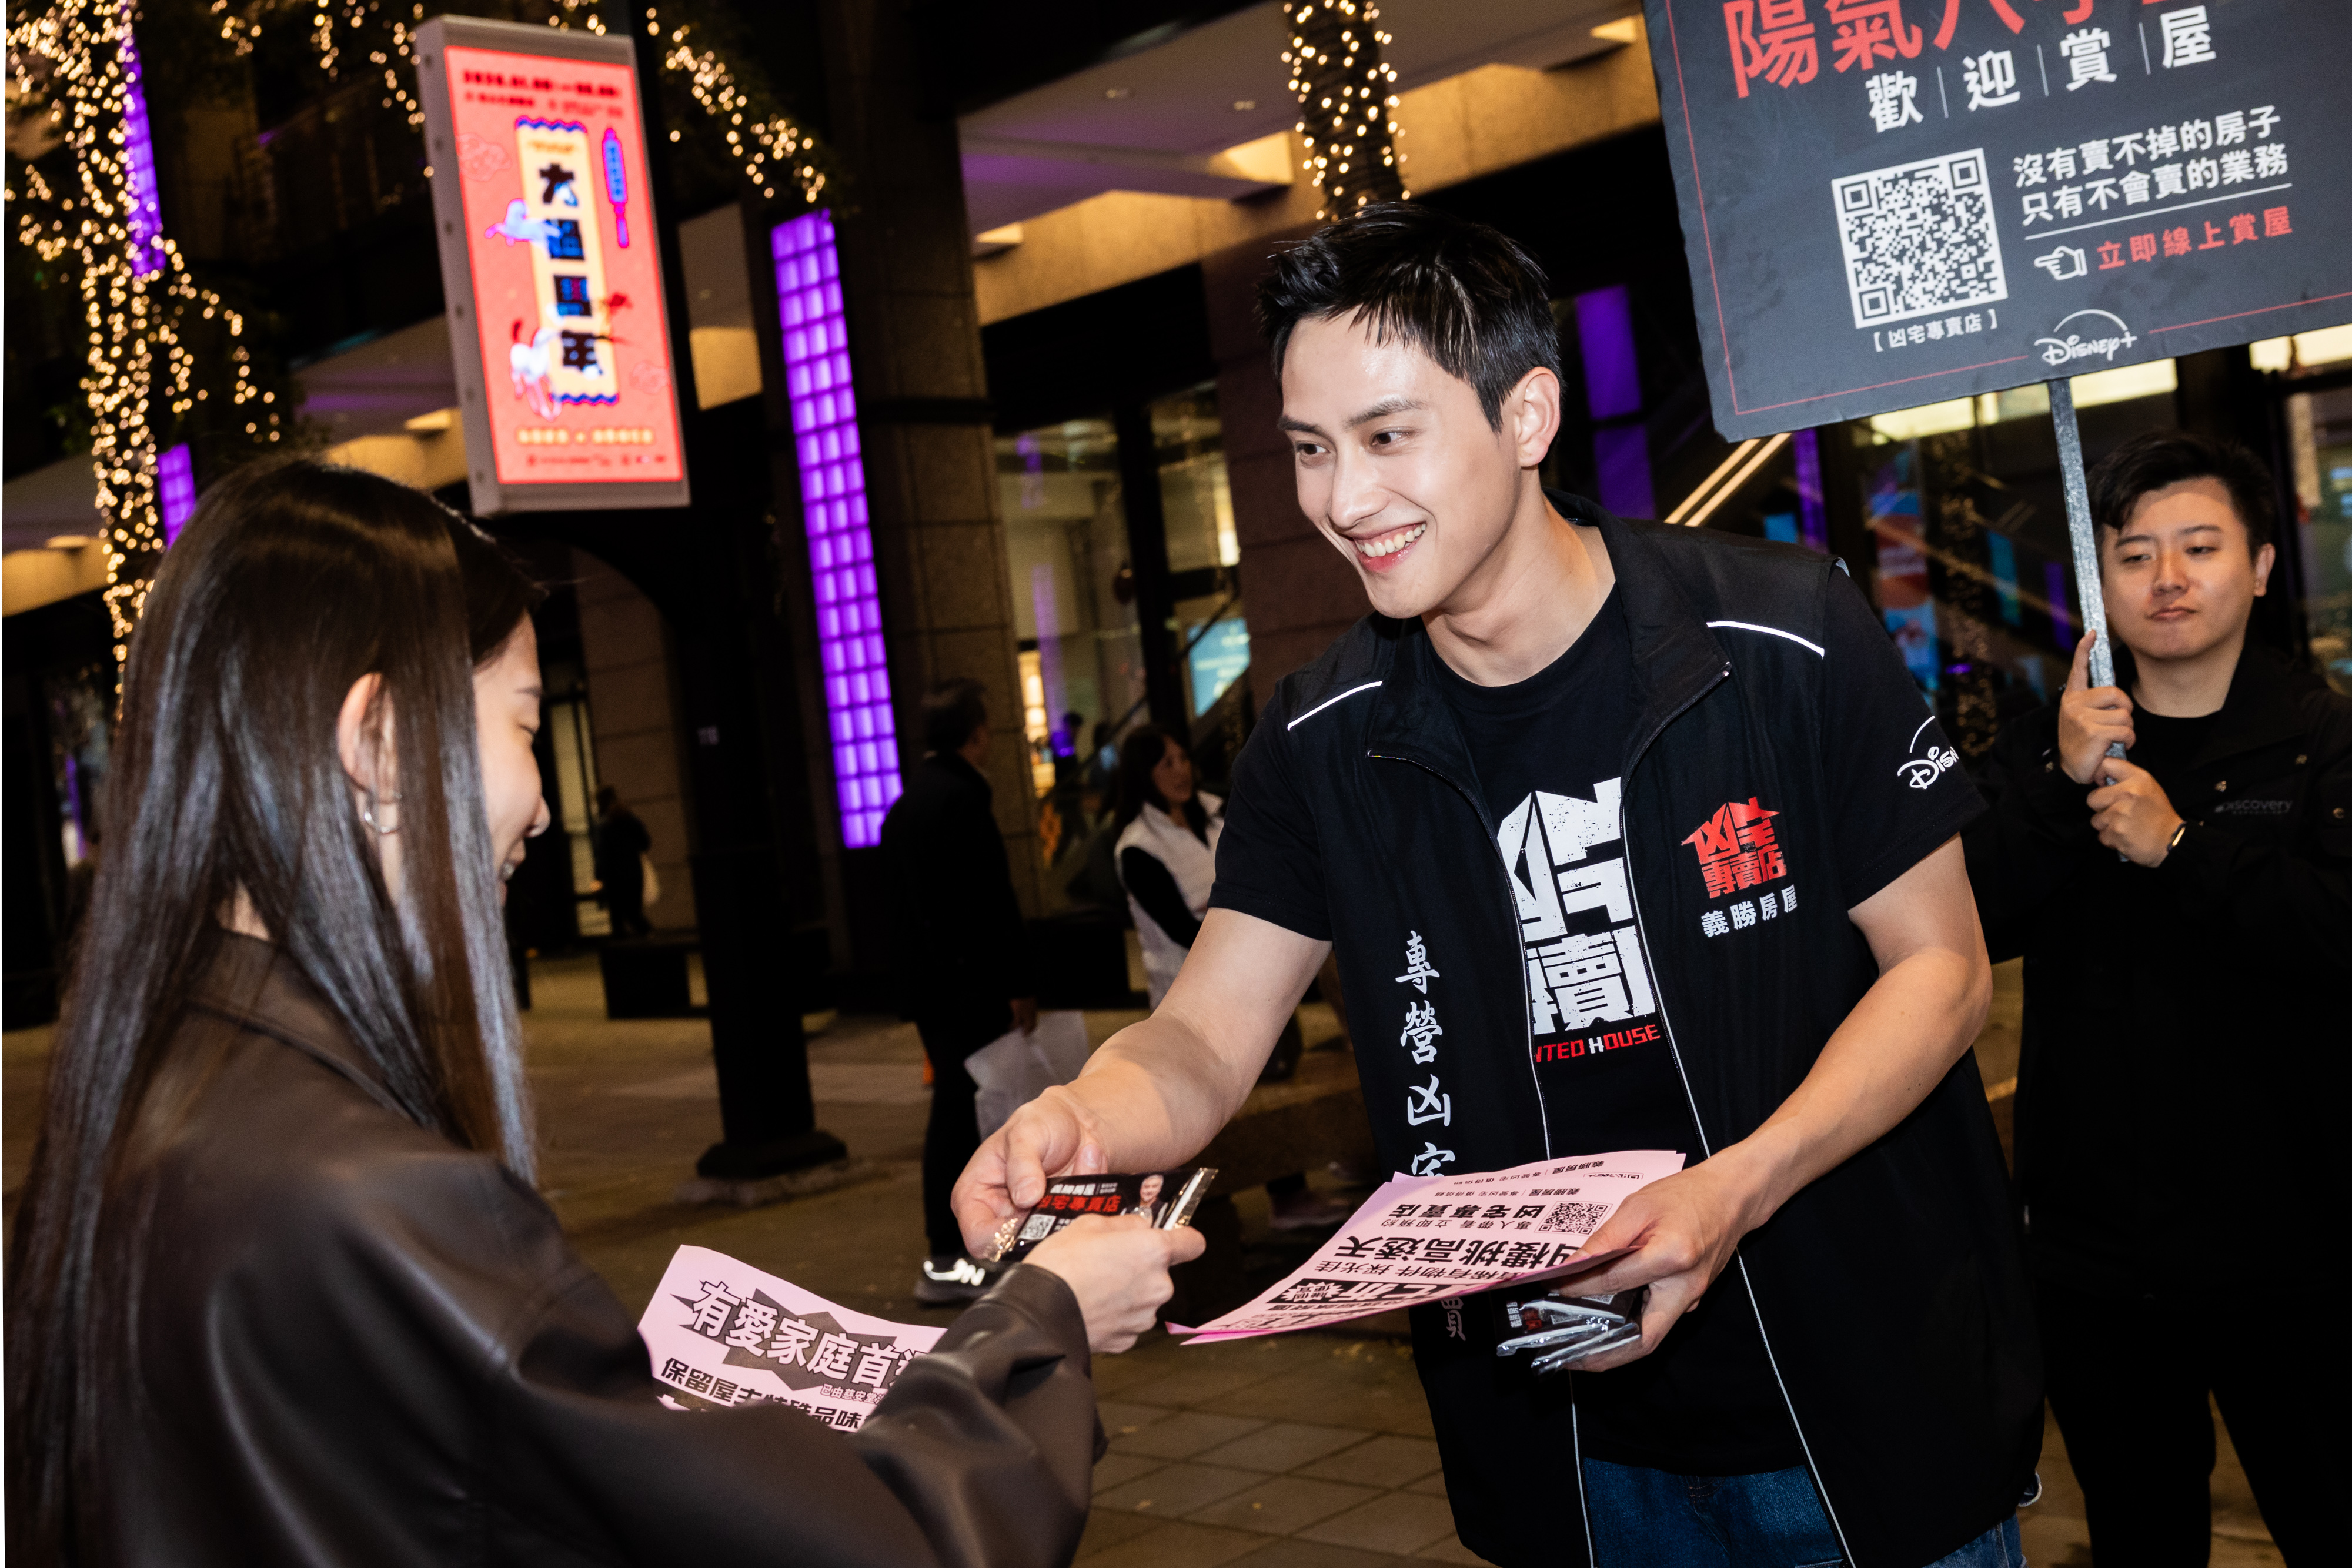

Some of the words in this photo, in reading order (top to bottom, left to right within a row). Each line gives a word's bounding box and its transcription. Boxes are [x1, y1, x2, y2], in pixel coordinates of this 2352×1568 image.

[2013, 105, 2280, 188] 沒有賣不掉的房子
[2023, 143, 2288, 226] 只有不會賣的業務
[2097, 206, 2293, 270] 立即線上賞屋
[2034, 329, 2138, 366] Disney+
[1701, 884, 1798, 937] 義勝房屋
[1588, 1025, 1660, 1054] HOUSE
[1552, 1161, 1604, 1174] 義勝房屋
[1528, 1188, 1581, 1196] 義勝房屋
[1388, 1205, 1546, 1219] 凶宅專賣店
[1381, 1219, 1452, 1230] 立即預約
[1460, 1220, 1532, 1230] 專人帶看
[1314, 1261, 1393, 1275] 採光佳
